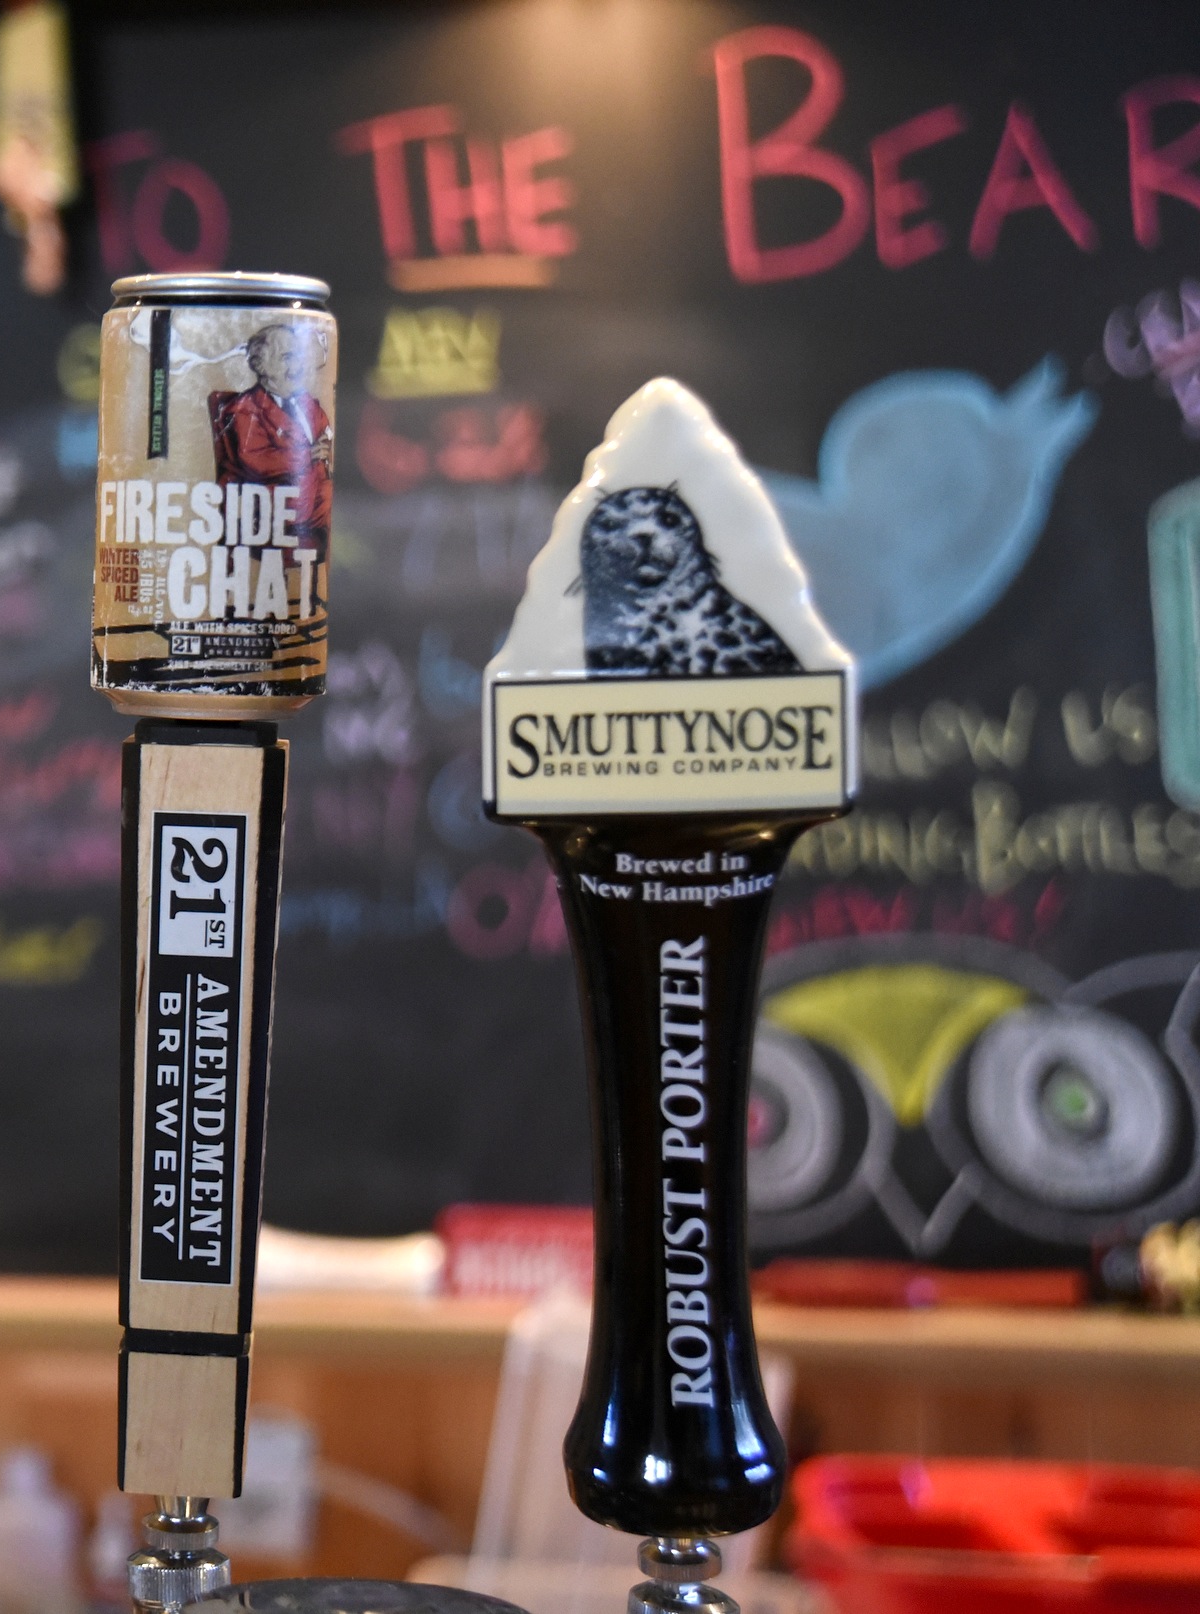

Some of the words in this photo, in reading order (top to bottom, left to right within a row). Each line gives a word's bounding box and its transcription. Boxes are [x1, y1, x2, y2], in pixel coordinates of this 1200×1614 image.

[333, 105, 578, 258] THE
[99, 480, 300, 547] FIRESIDE
[99, 547, 140, 565] WINTER
[100, 566, 139, 584] SPICED
[114, 585, 138, 603] ALE
[167, 545, 317, 621] CHAT
[170, 620, 191, 634] ALE
[194, 621, 225, 635] WITH
[204, 635, 271, 648] AMENDMENT
[506, 704, 834, 779] SMUTTYNOSE
[543, 761, 659, 777] BREWING
[673, 756, 798, 775] COMPANY
[615, 852, 712, 875] Brewed
[720, 852, 746, 872] in
[578, 873, 633, 901] New
[642, 872, 776, 907] Hampshire
[659, 935, 709, 1164] PORTER
[152, 991, 182, 1243] BREWERY
[189, 973, 230, 1267] AMENDMENT
[662, 1177, 714, 1409] ROBUST
